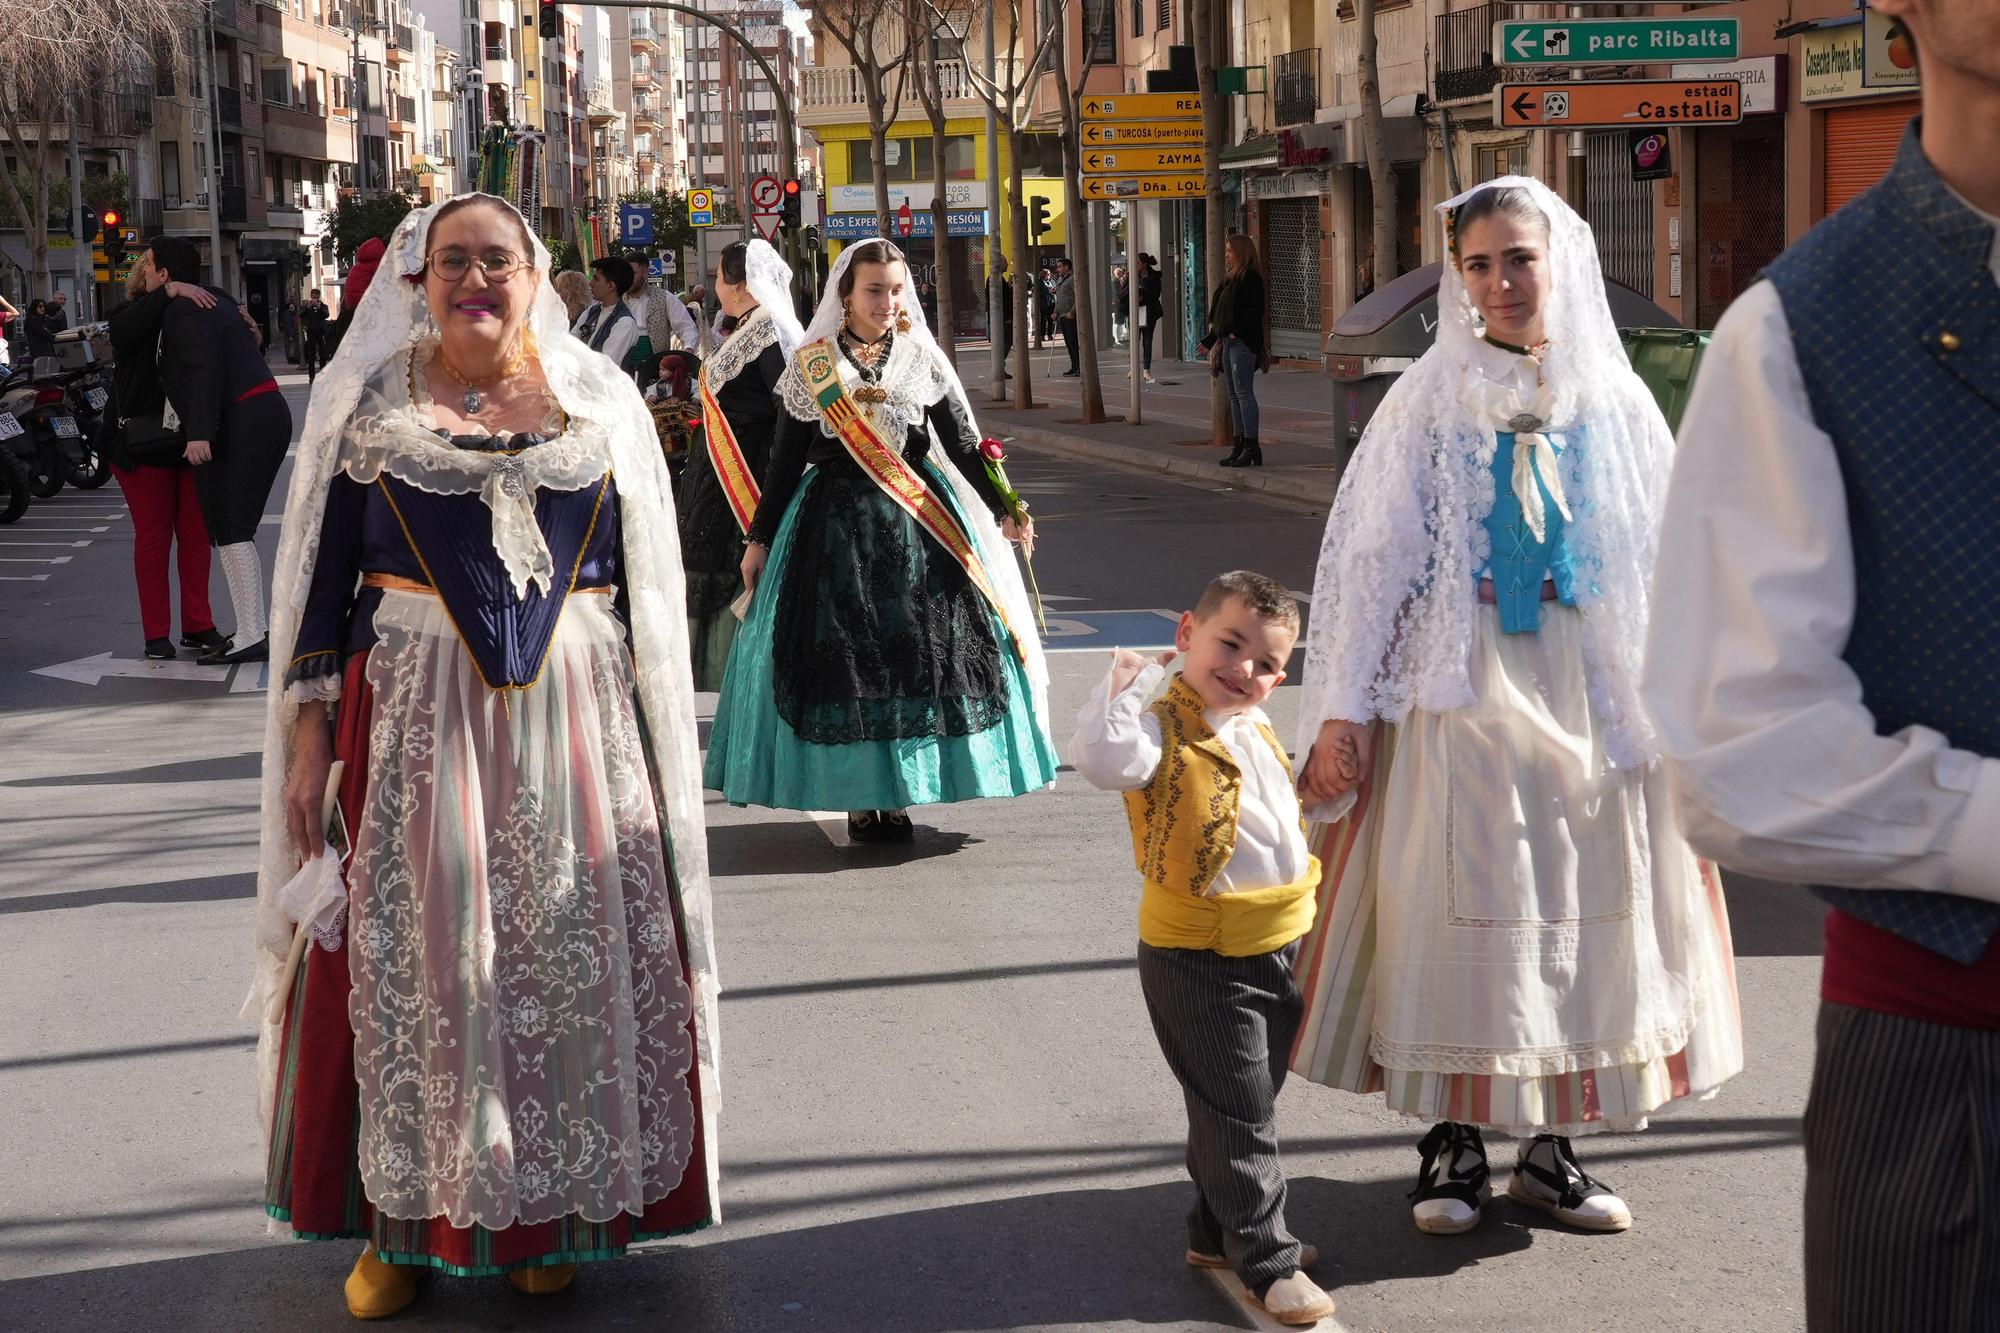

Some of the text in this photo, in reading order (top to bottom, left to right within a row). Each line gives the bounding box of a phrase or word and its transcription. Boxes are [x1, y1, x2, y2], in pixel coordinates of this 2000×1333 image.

[1589, 28, 1731, 52] parc Ribalta
[1805, 45, 1830, 77] Cosecha
[1853, 39, 1863, 71] Na
[1684, 84, 1733, 97] estadi
[1176, 100, 1202, 110] REA
[1637, 101, 1733, 119] Castalia
[1117, 127, 1204, 138] TURCOSA (puerto-playa
[1158, 154, 1202, 164] ZAYMA
[1143, 182, 1171, 192] Dña.
[946, 193, 971, 203] OLOR
[627, 214, 645, 236] P
[826, 217, 845, 227] LOS
[848, 215, 896, 227] EXPERS
[127, 232, 134, 241] P
[0, 413, 14, 425] 884
